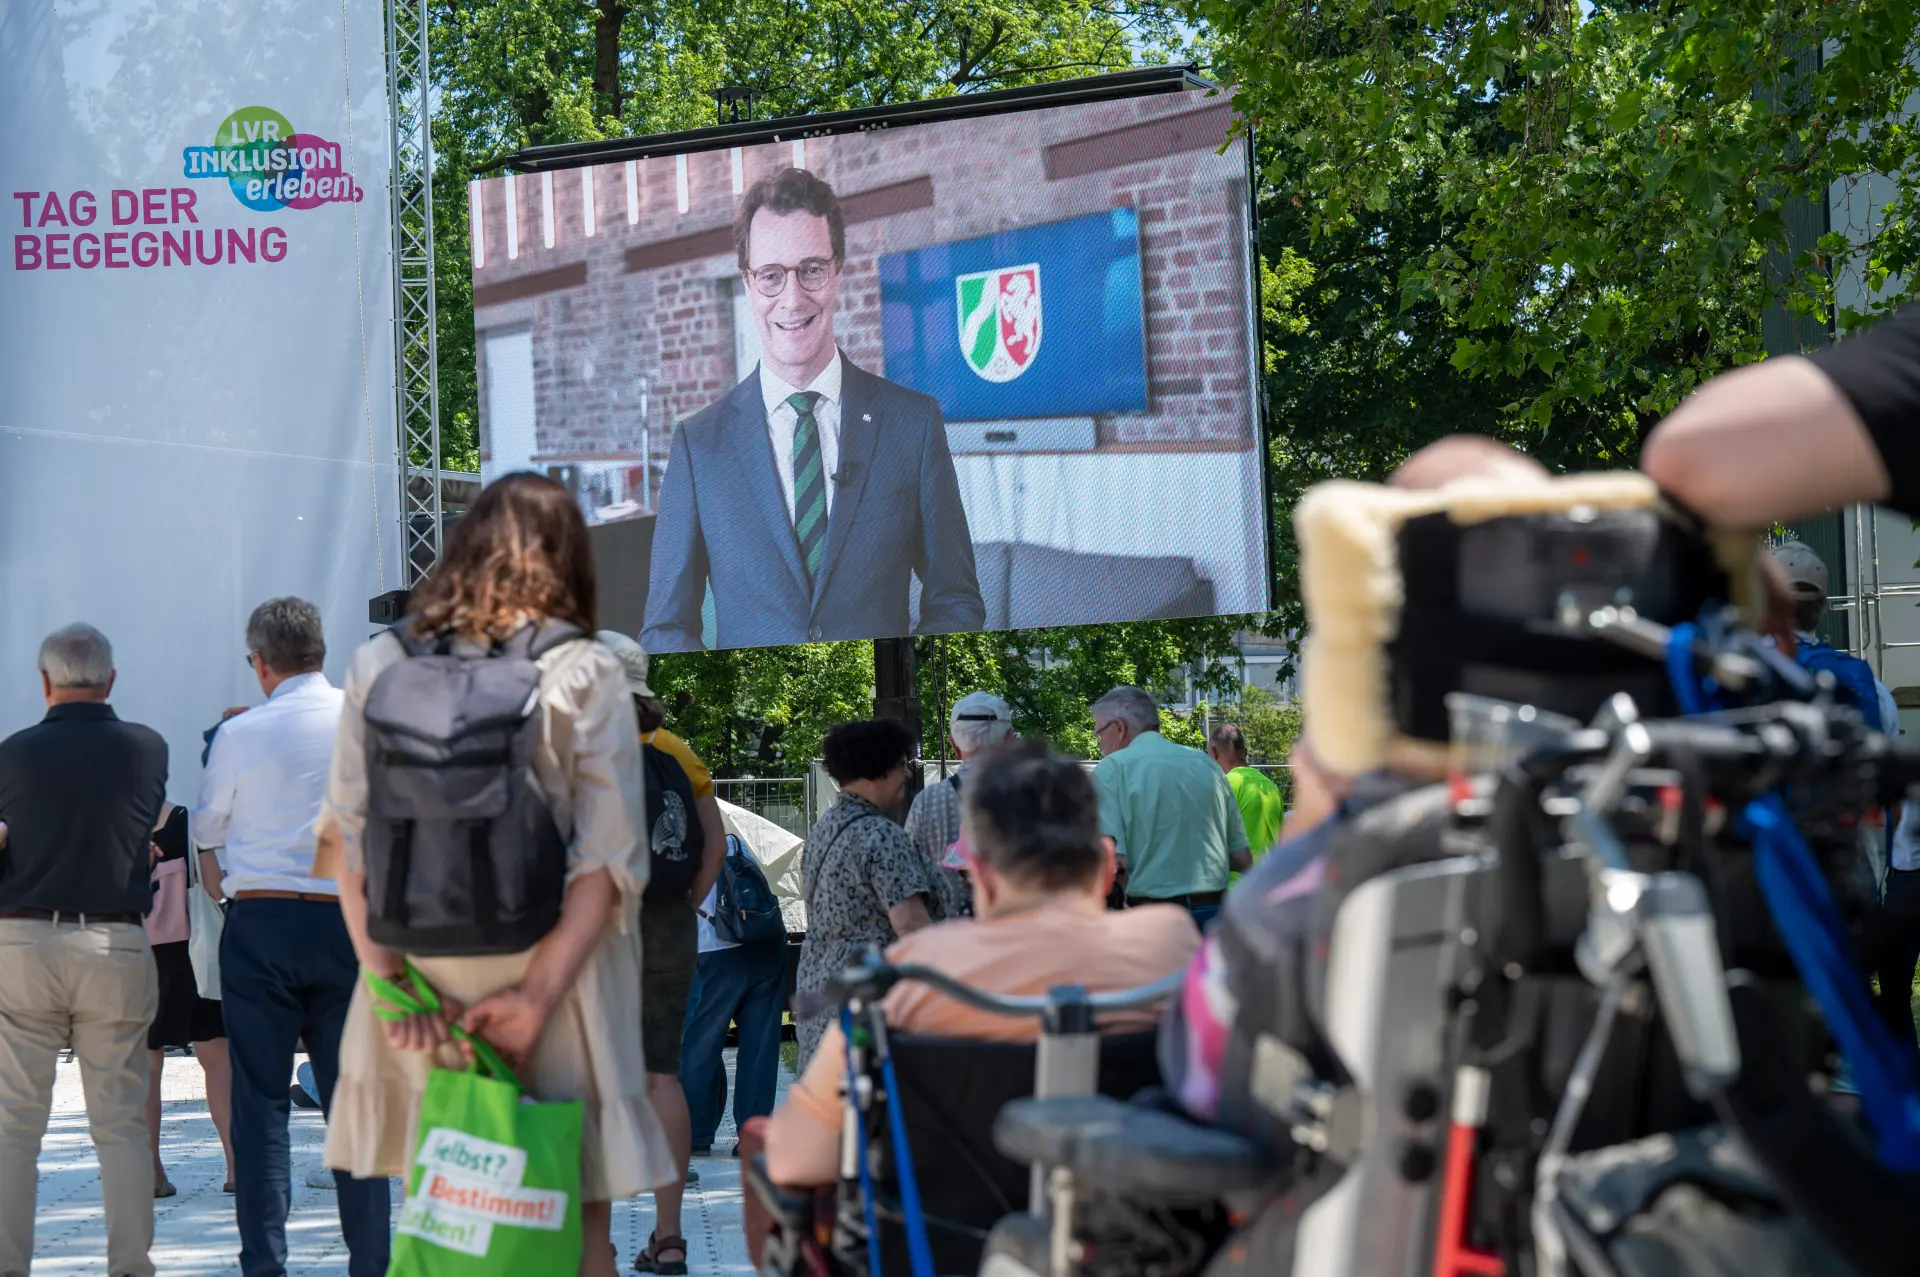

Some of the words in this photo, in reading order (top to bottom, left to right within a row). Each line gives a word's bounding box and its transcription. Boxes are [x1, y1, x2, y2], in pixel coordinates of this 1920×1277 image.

[231, 120, 287, 144] LVR.
[188, 147, 337, 174] INKLUSION
[246, 171, 359, 200] erleben.
[14, 190, 97, 227] TAG
[111, 188, 199, 225] DER
[14, 226, 288, 270] BEGEGNUNG
[432, 1136, 508, 1178] elbst?
[428, 1174, 556, 1222] Bestimmt!
